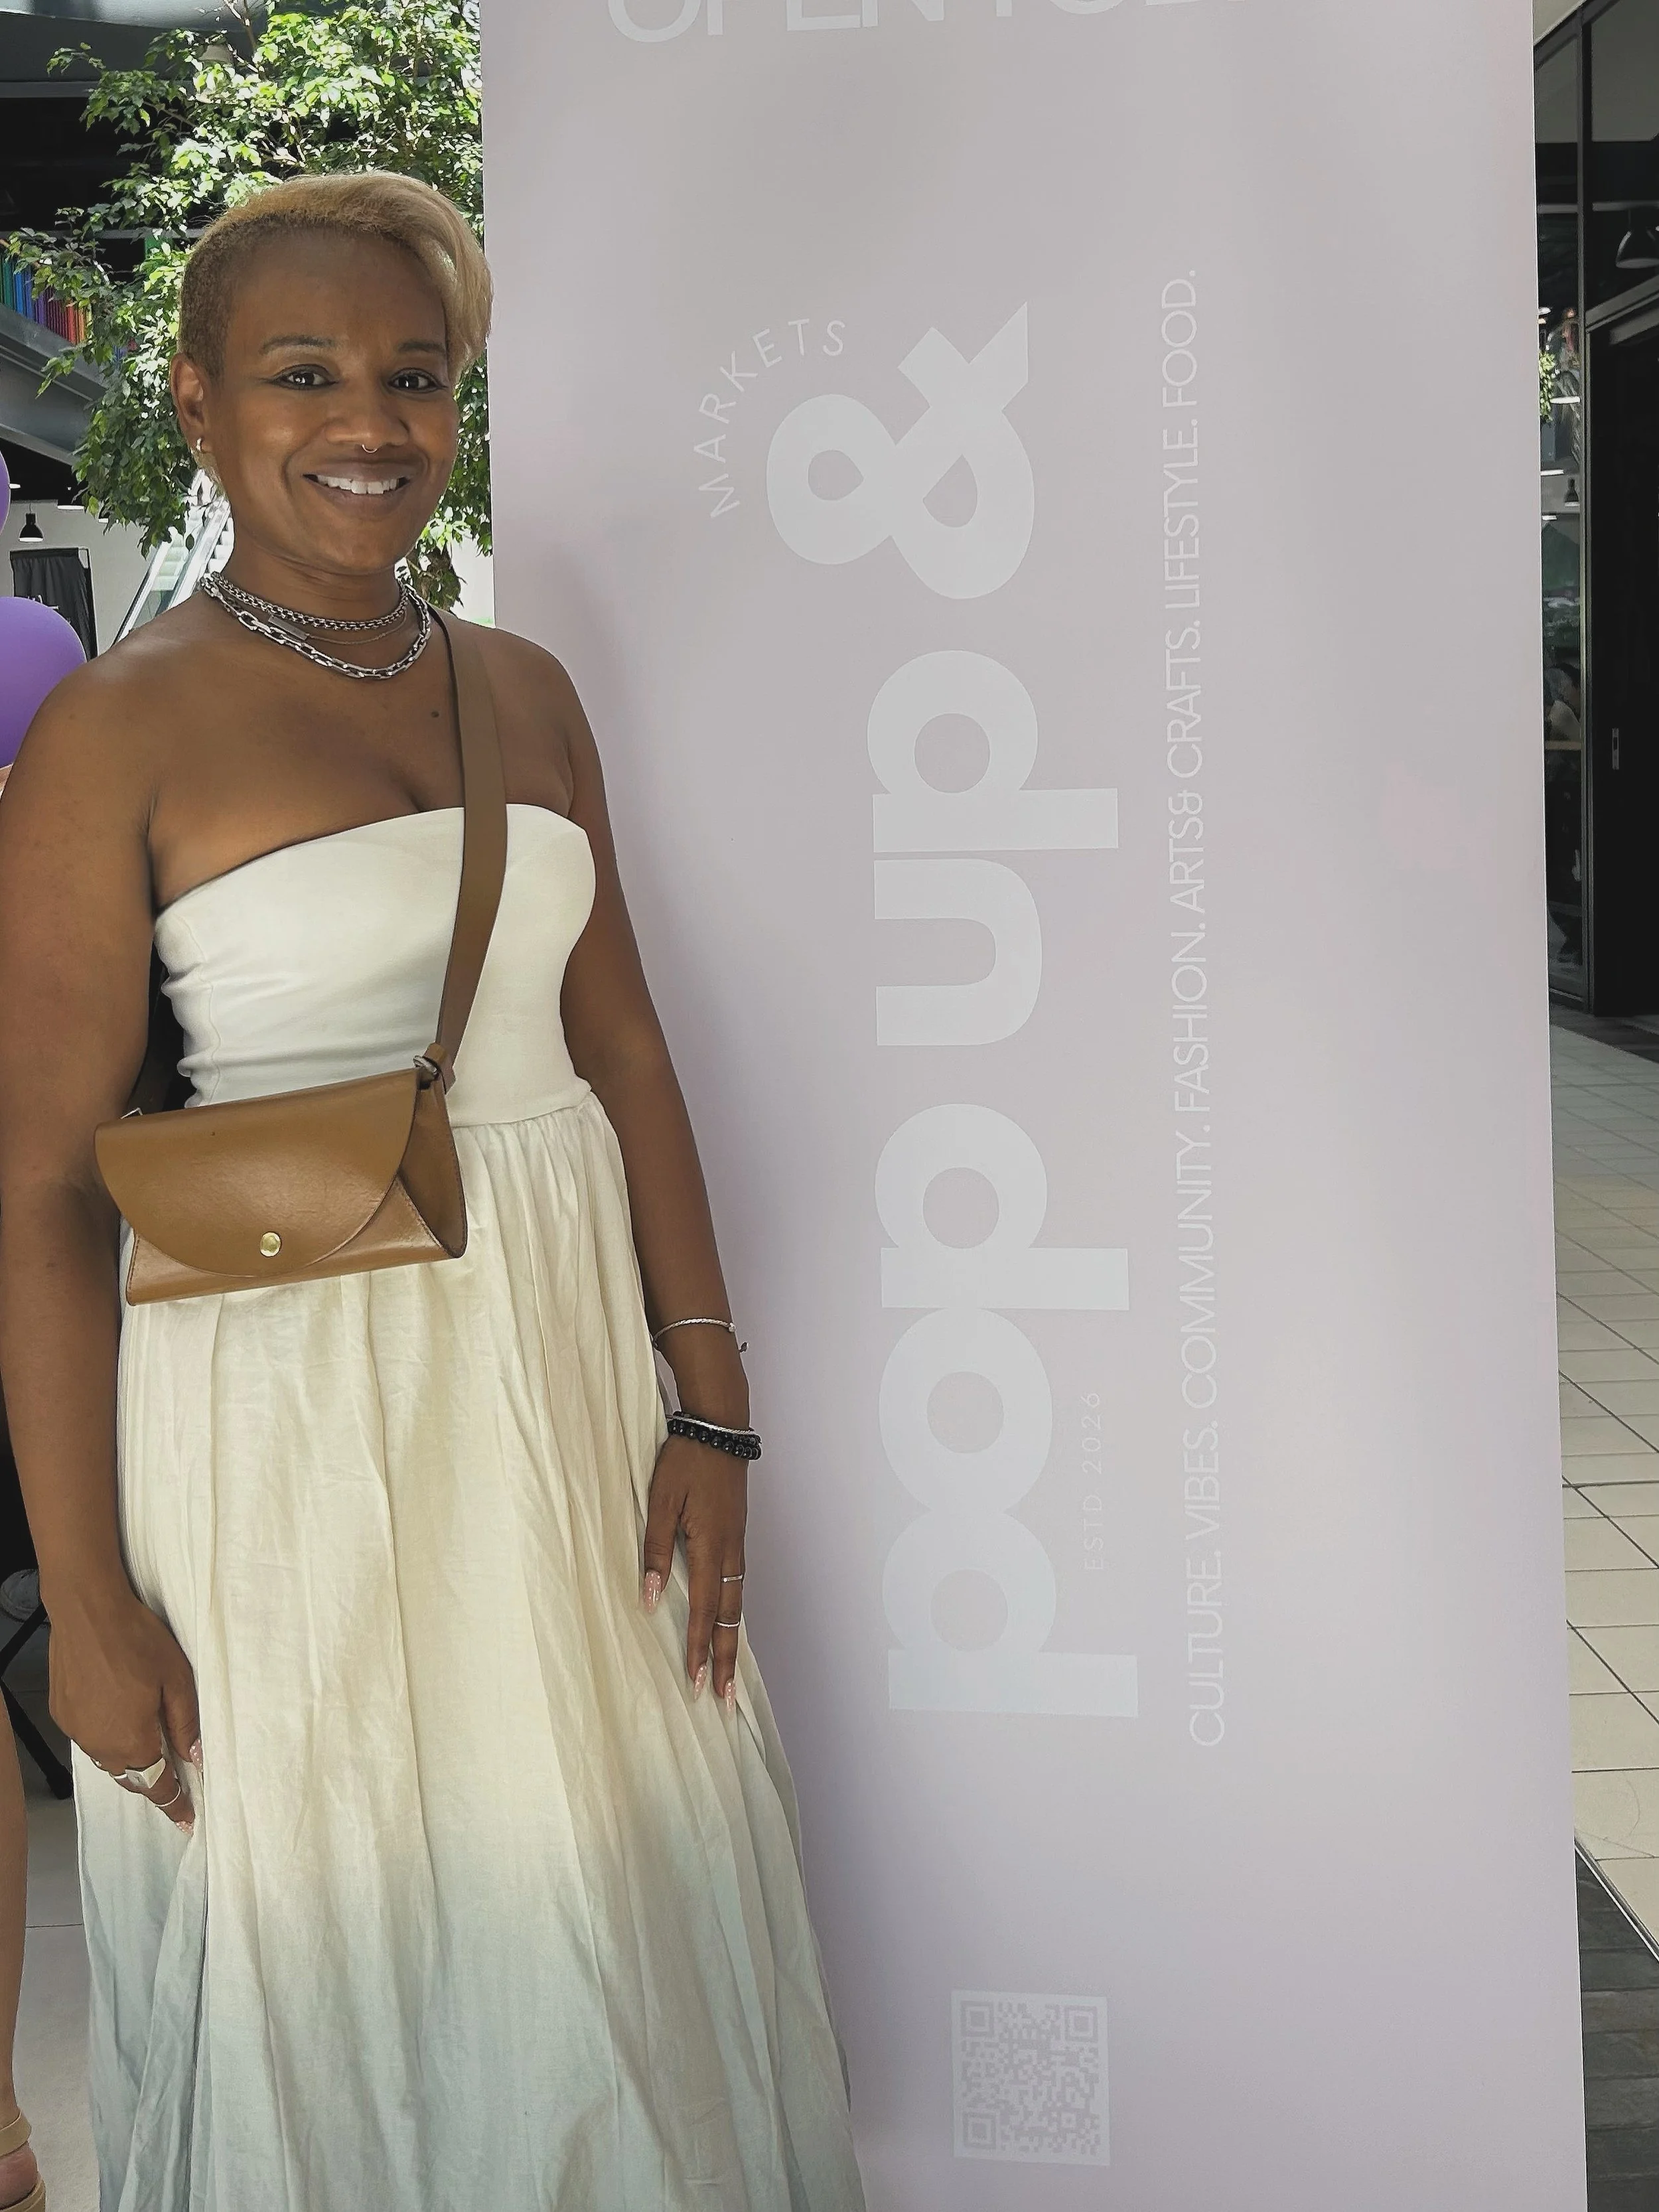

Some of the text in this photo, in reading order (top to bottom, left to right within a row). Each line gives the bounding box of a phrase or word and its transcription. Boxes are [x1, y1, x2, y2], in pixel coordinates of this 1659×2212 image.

[693, 318, 846, 519] MARKETS
[1161, 269, 1198, 407] FOOD.
[766, 301, 1035, 599] &
[1162, 419, 1200, 609] LIFESTYLE.
[1165, 620, 1203, 778] CRAFTS.
[867, 650, 1119, 1046] up
[1171, 922, 1210, 1112] FASHION.
[1175, 1125, 1217, 1408] COMMUNITY.
[875, 1102, 1139, 1718] pop
[1080, 1392, 1104, 1571] ESTD 2026
[1183, 1421, 1220, 1540] VIBES.
[1187, 1550, 1225, 1747] CULTURE.
